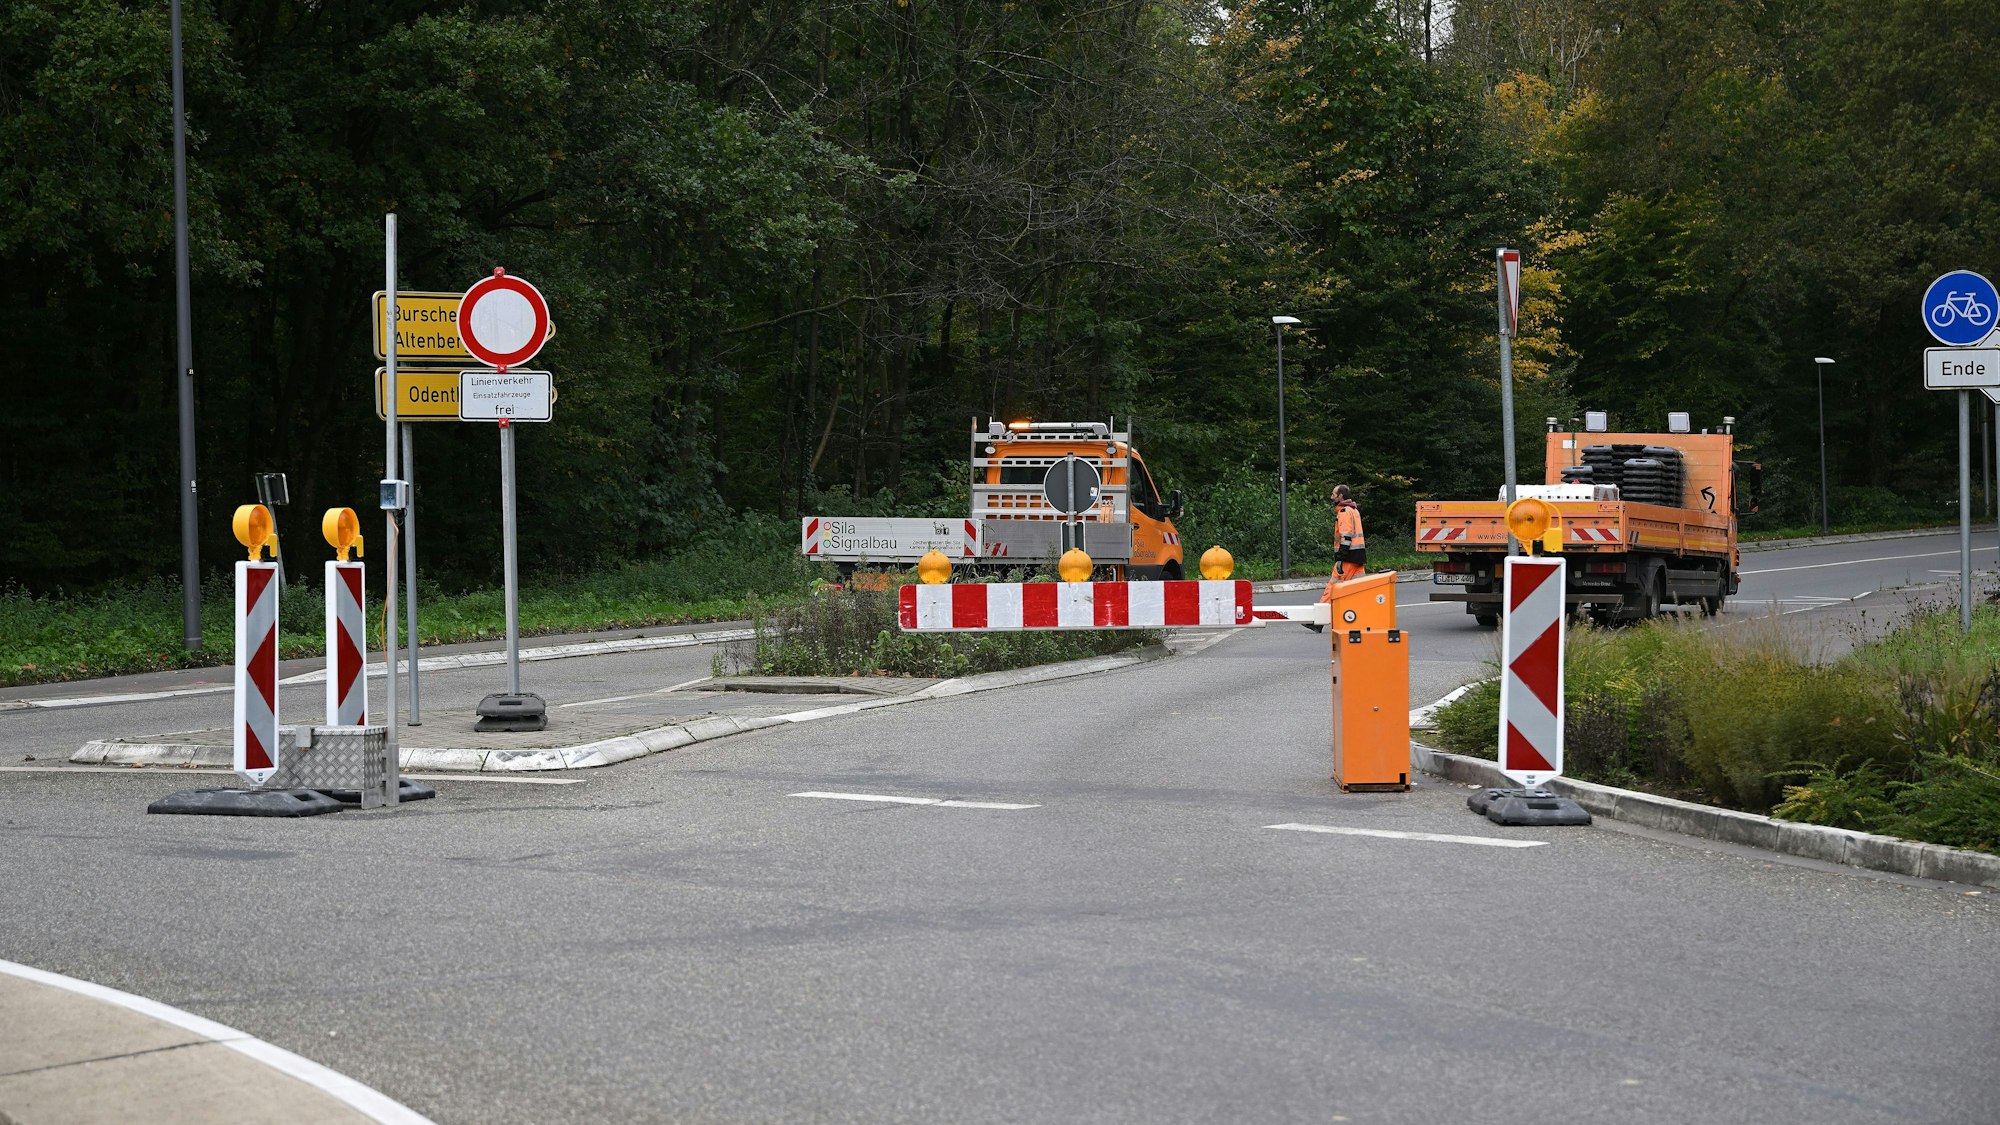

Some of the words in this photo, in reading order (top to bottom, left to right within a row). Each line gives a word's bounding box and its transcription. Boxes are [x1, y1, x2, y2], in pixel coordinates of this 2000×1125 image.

[396, 331, 469, 354] Altenber
[1942, 361, 1985, 376] Ende
[471, 376, 534, 386] Linienverkehr
[473, 391, 531, 399] Einsatzfahrzeuge
[495, 404, 515, 415] frei
[831, 521, 856, 535] Sila
[831, 535, 897, 552] Signalbau
